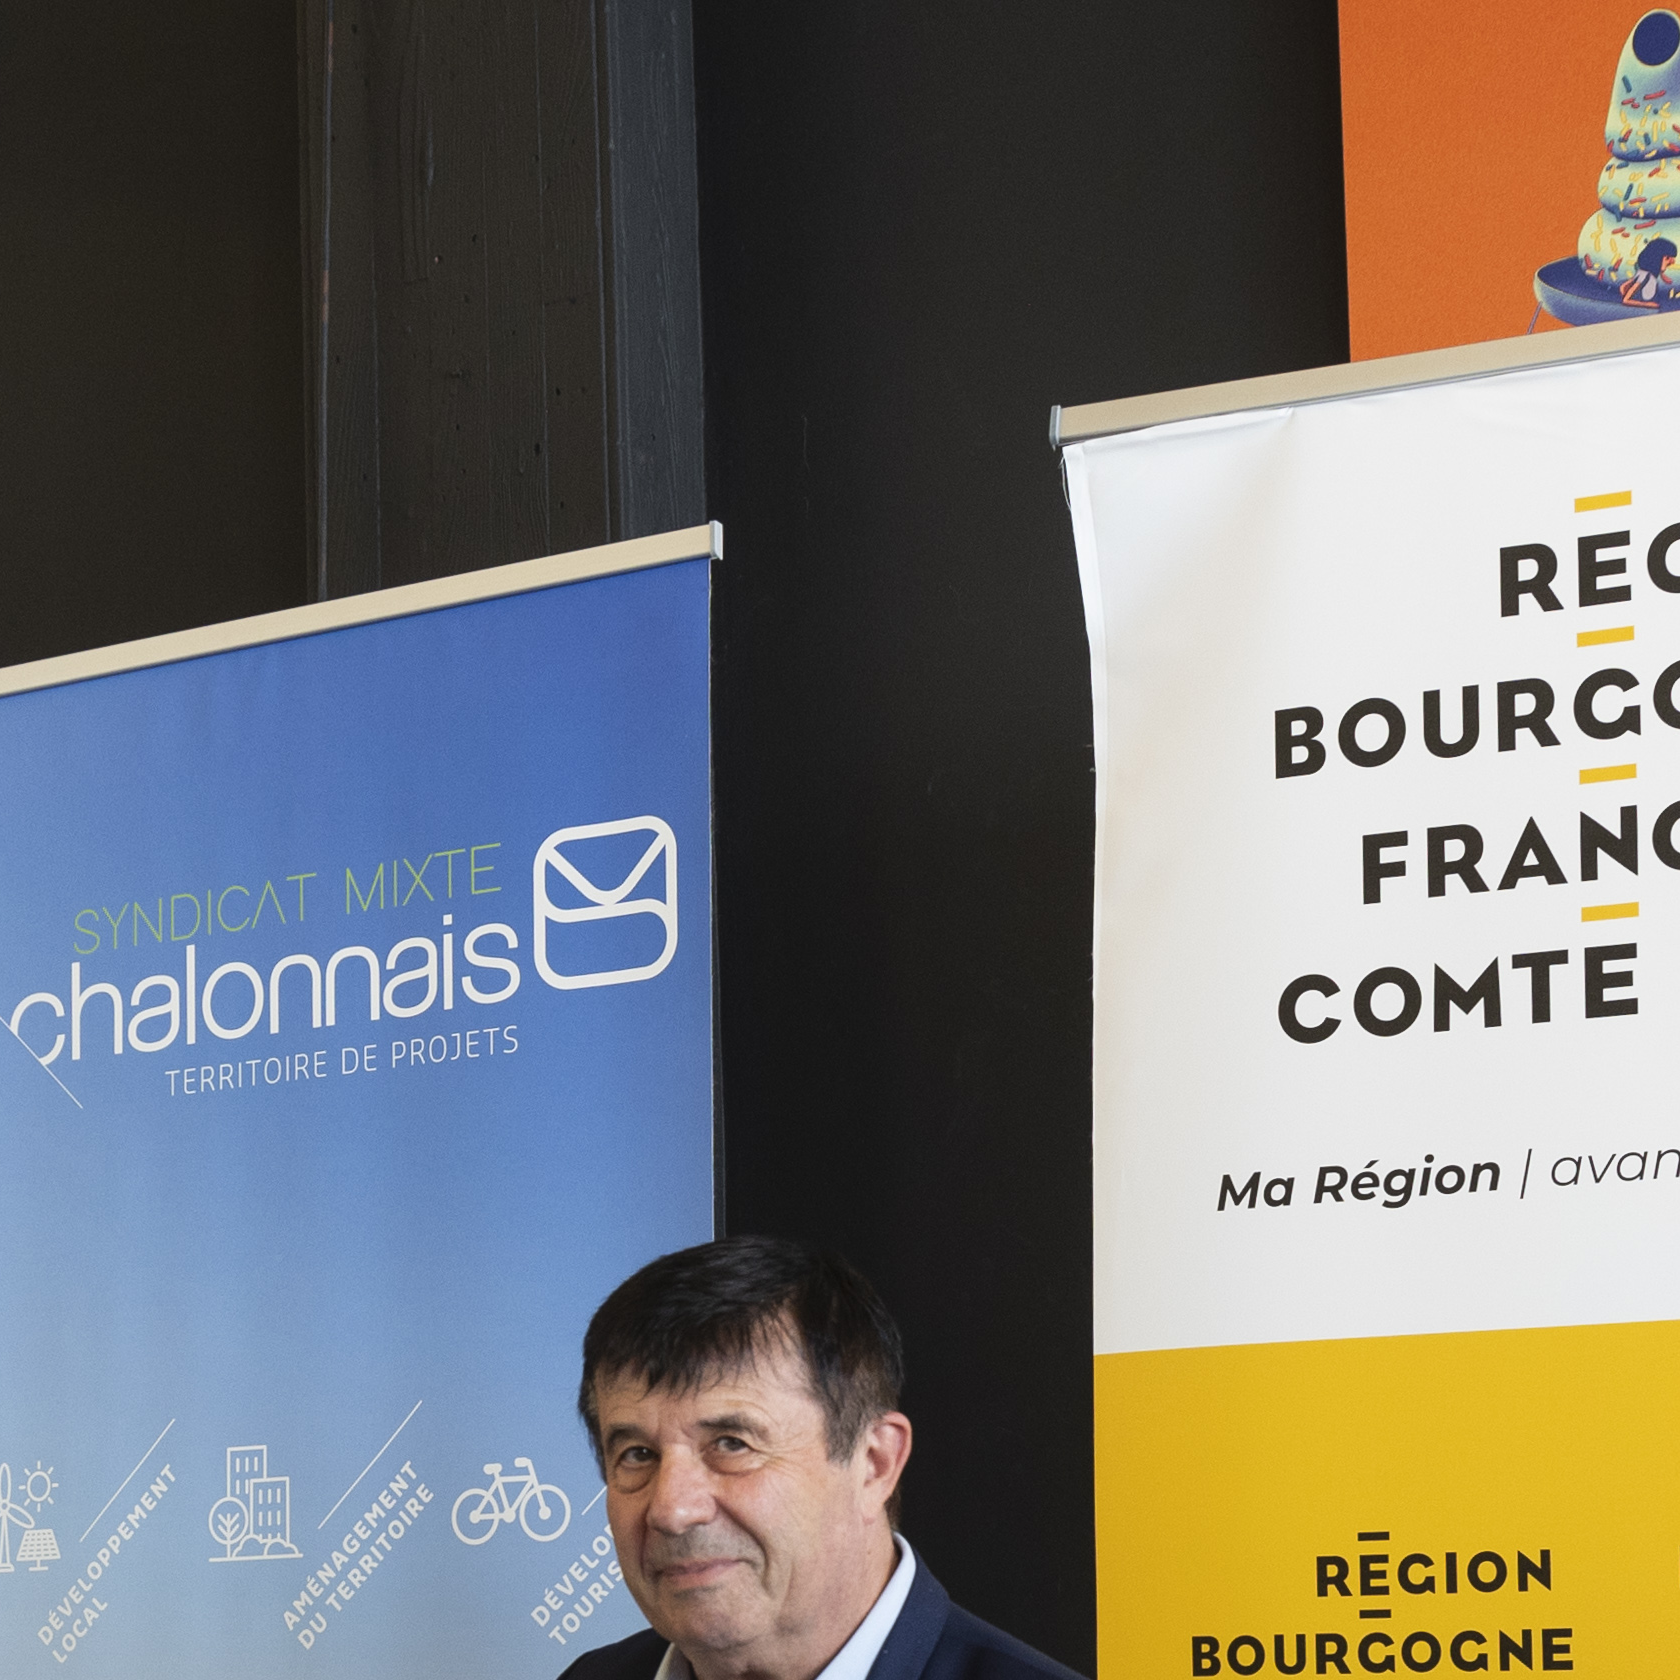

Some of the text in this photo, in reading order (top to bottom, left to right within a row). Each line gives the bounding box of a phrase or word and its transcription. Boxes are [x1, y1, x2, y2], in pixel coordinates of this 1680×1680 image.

[73, 842, 501, 955] SYNDICAT MIXTE
[9, 914, 521, 1067] chalonnais
[165, 1025, 519, 1096] TERRITOIRE DE PROJETS
[1216, 1173, 1295, 1211] Ma
[1313, 1157, 1501, 1210] Région
[38, 1463, 176, 1646] DÉVELOPPEMENT
[283, 1460, 417, 1631] AMÉNAGEMENT
[297, 1483, 434, 1650] DU TERRITOIRE
[52, 1598, 108, 1663] LOCAL
[1191, 1628, 1574, 1677] BOURGOGNE
